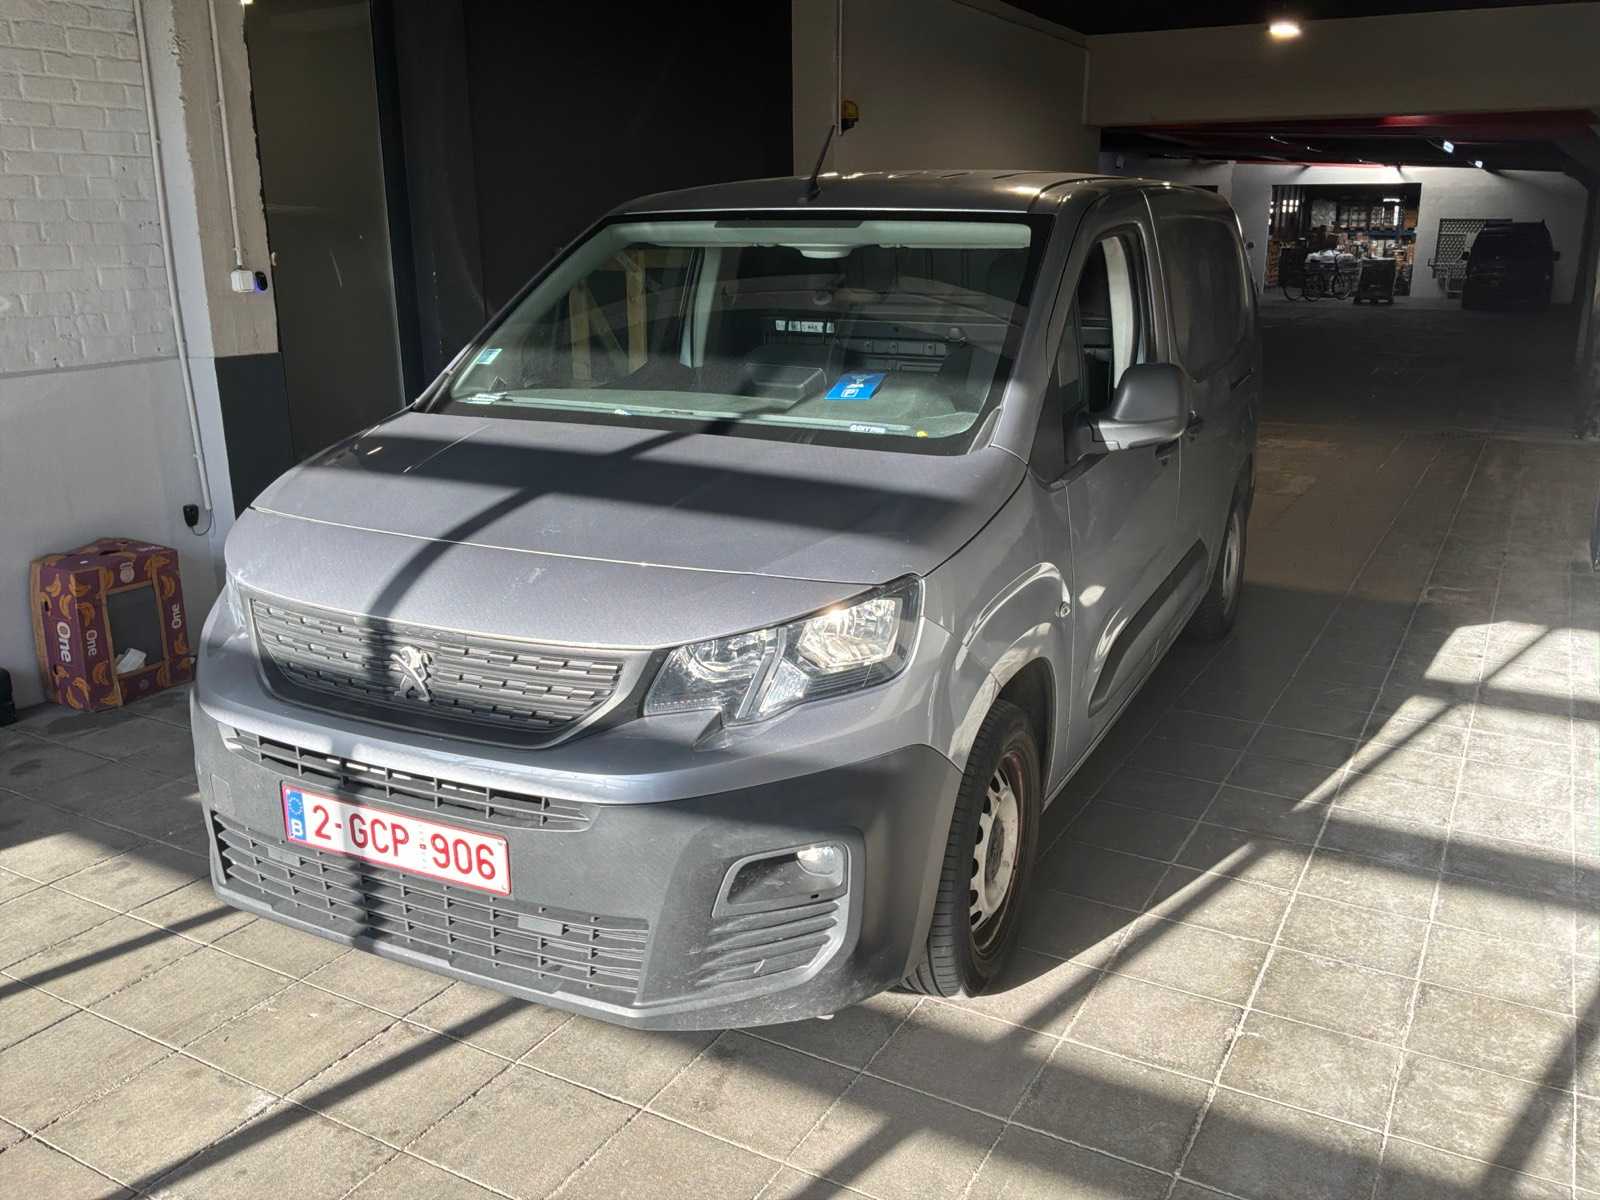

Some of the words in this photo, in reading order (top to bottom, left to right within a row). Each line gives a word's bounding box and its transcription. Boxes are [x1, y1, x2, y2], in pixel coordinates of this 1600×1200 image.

[171, 604, 182, 629] One
[57, 622, 72, 663] One
[86, 629, 97, 656] One
[291, 821, 303, 836] B
[313, 805, 496, 880] 2-GCP-906
